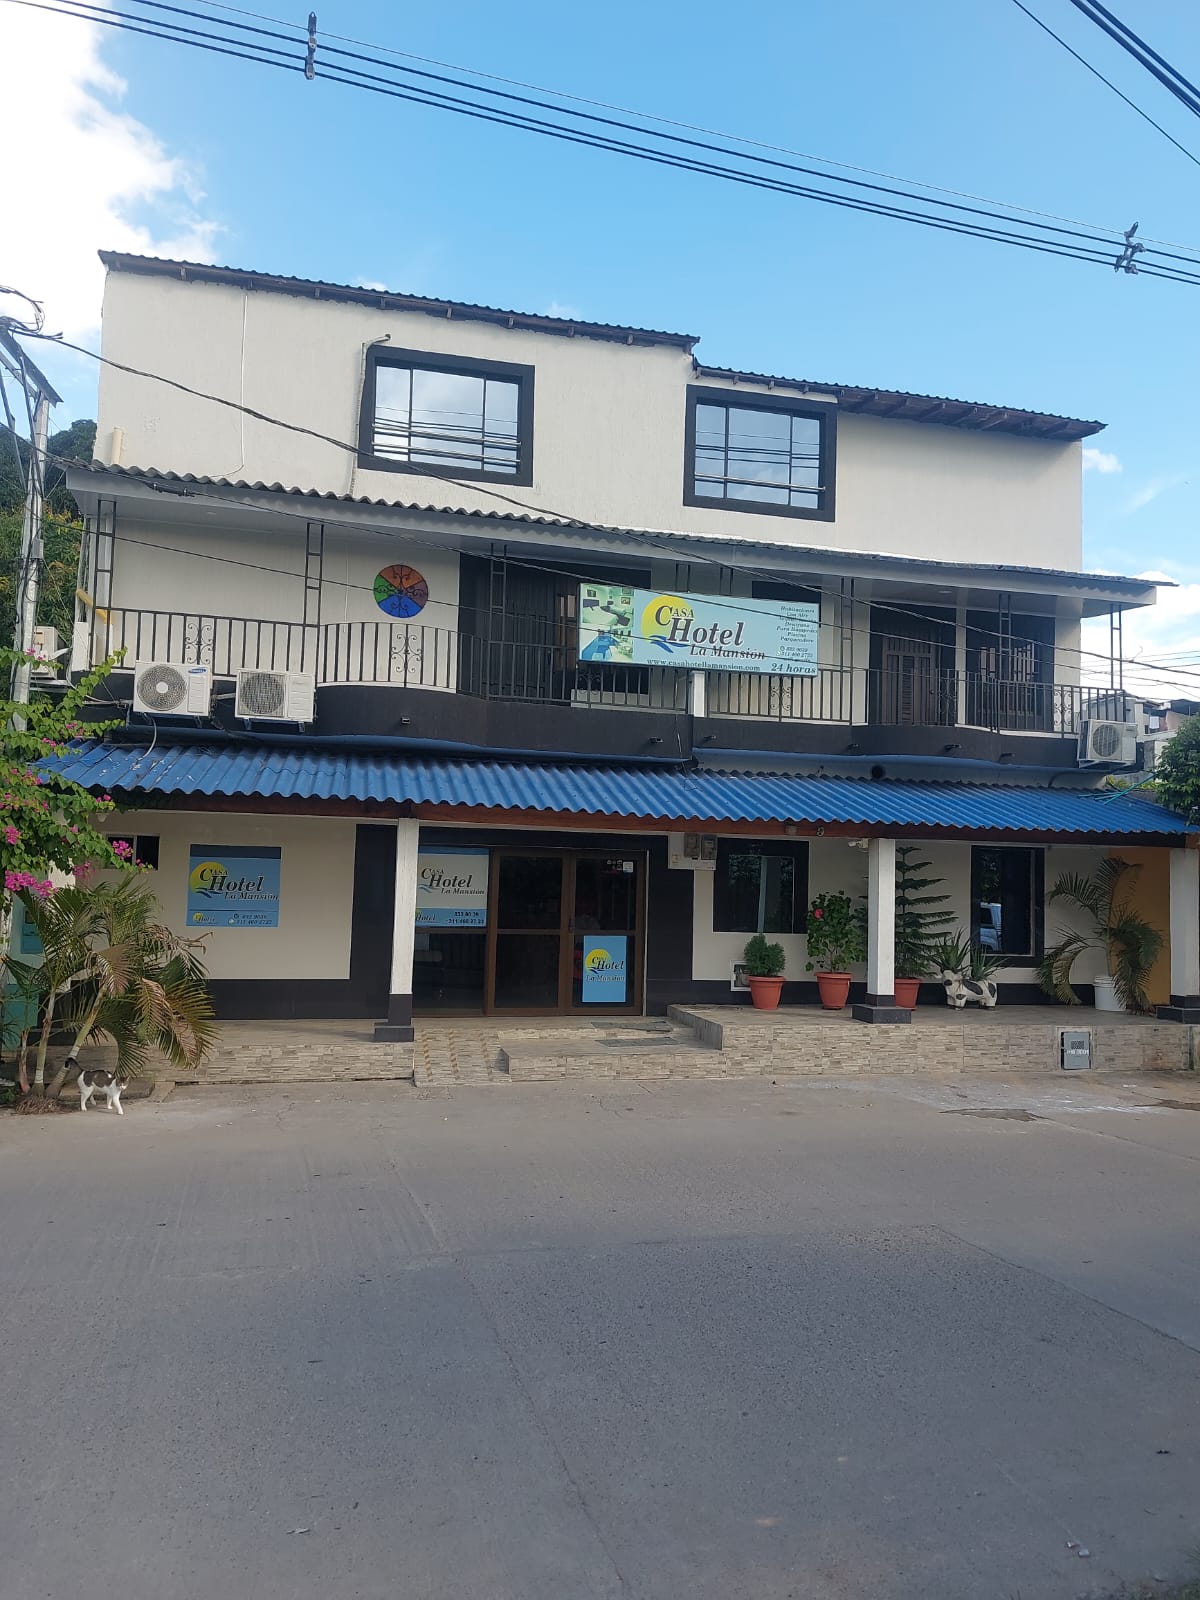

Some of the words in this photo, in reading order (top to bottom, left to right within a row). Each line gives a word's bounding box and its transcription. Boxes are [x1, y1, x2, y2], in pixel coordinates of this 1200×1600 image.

[655, 605, 694, 626] CASA
[667, 617, 745, 646] Hotel
[690, 643, 707, 656] La
[646, 659, 761, 672] www.casahotellamansion.com
[771, 662, 784, 672] 24
[785, 663, 817, 674] horas
[208, 875, 264, 892] Hotel
[429, 874, 473, 888] Hotel
[224, 891, 236, 900] La
[596, 960, 624, 970] Hotel
